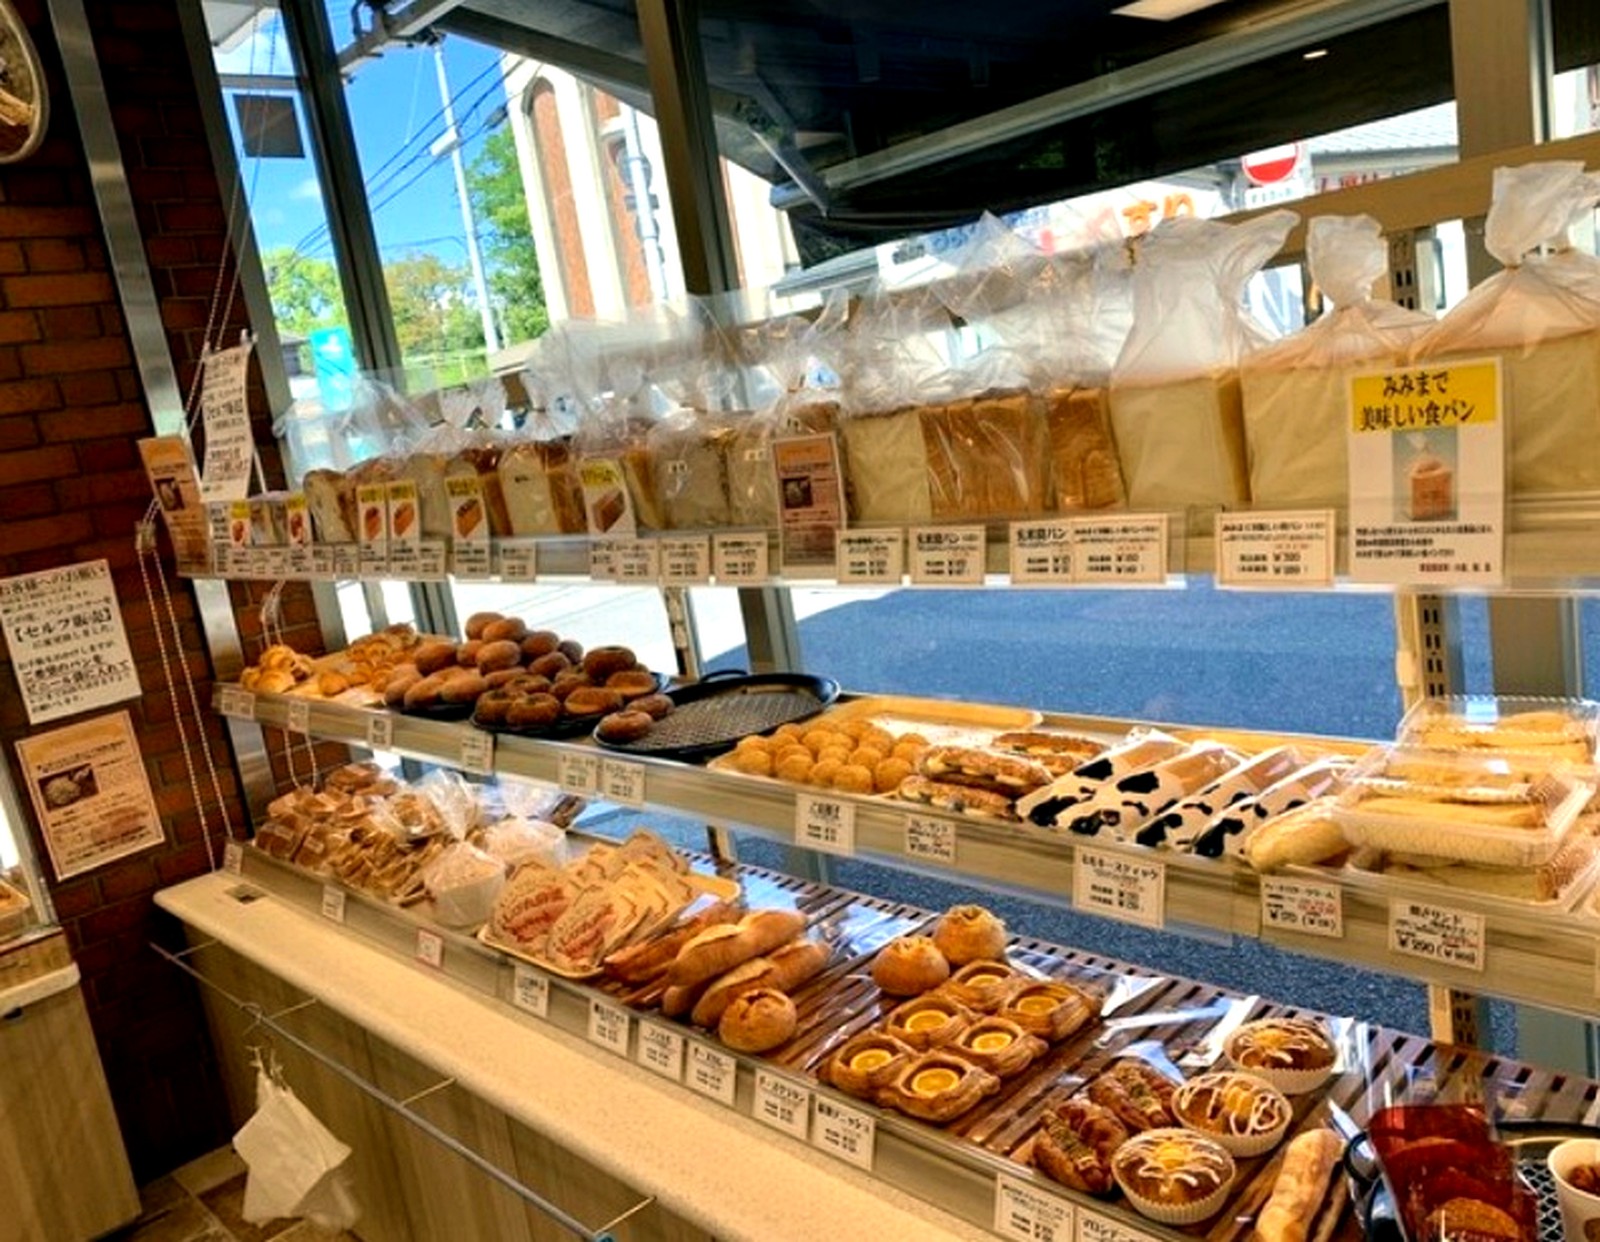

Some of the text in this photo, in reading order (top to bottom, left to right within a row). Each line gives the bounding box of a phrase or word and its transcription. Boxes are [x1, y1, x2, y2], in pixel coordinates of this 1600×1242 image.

[1383, 371, 1448, 397] みみまで
[1360, 401, 1475, 431] 美味しい食パン
[15, 607, 112, 642] 【セルフ販売】
